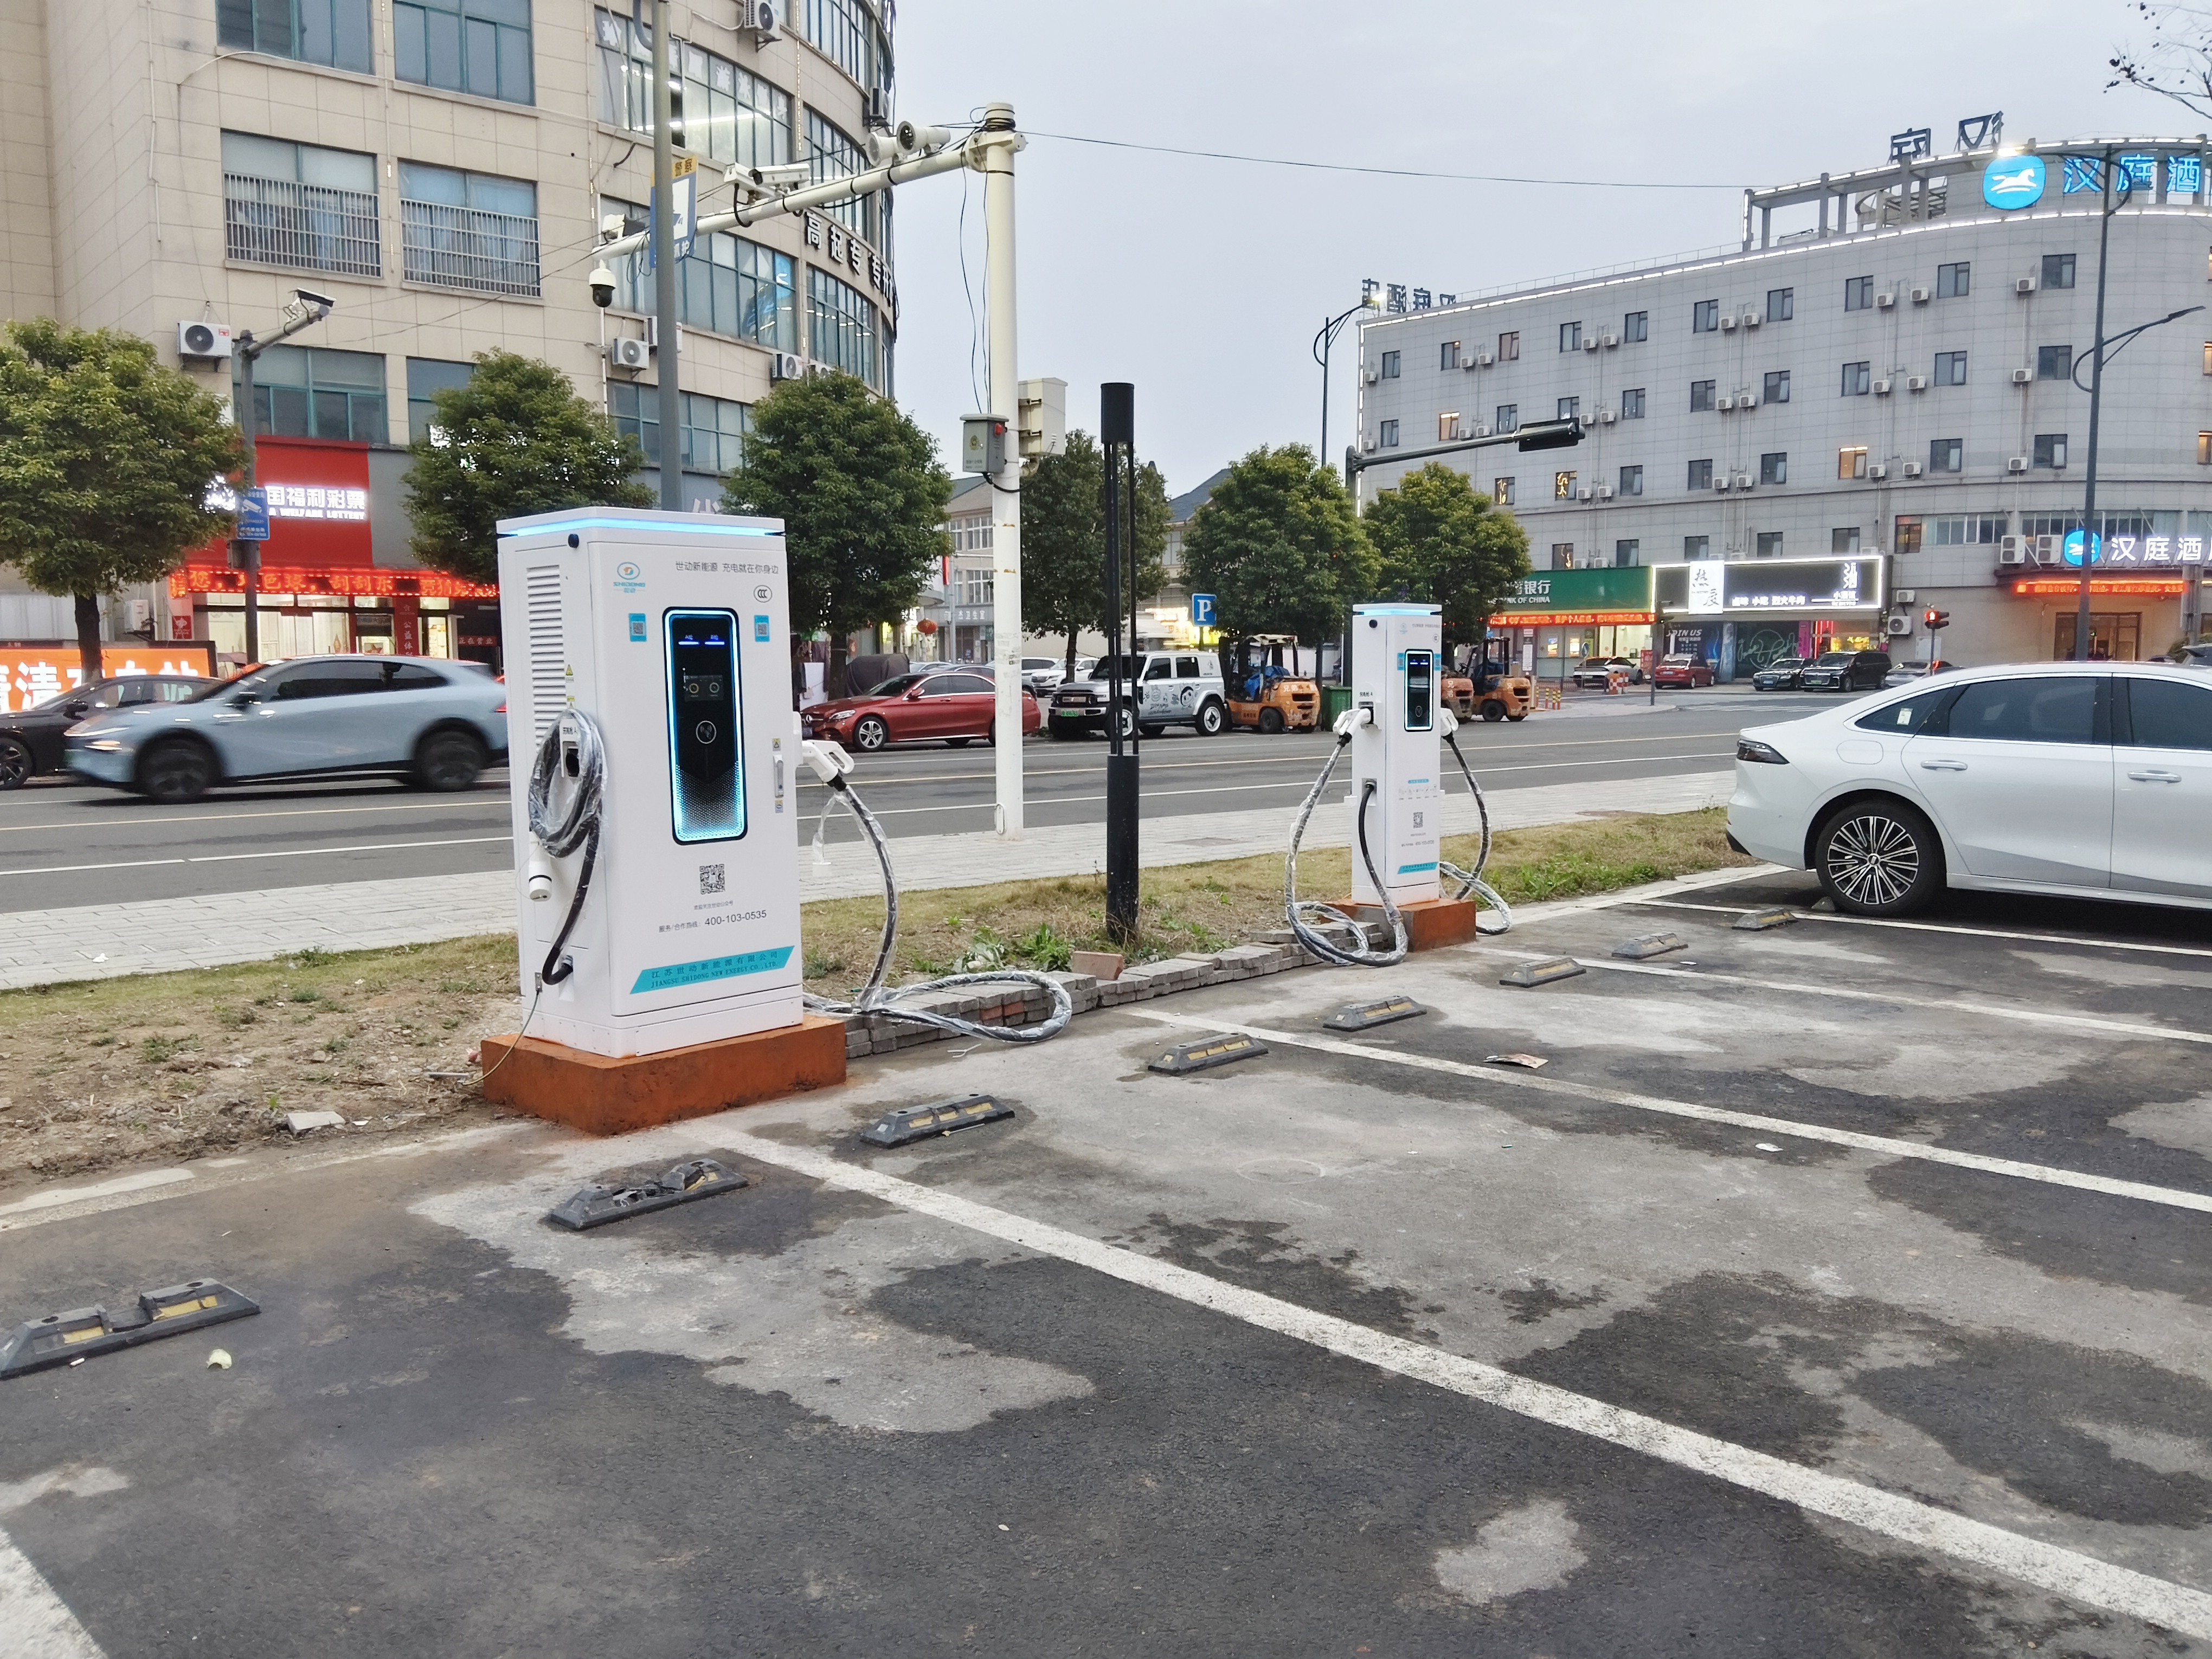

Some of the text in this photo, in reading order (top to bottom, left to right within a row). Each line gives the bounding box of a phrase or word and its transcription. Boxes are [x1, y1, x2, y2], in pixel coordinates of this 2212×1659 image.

[2063, 153, 2212, 193] 汉庭酒
[806, 211, 893, 306] 高起专 专升
[265, 485, 365, 509] 国福利彩票
[2111, 536, 2212, 561] 汉庭酒
[676, 561, 779, 574] 世动新能源 充电就在你身边
[1197, 599, 1212, 621] P
[704, 910, 767, 927] 400-103-0535
[725, 966, 748, 975] ENERGY
